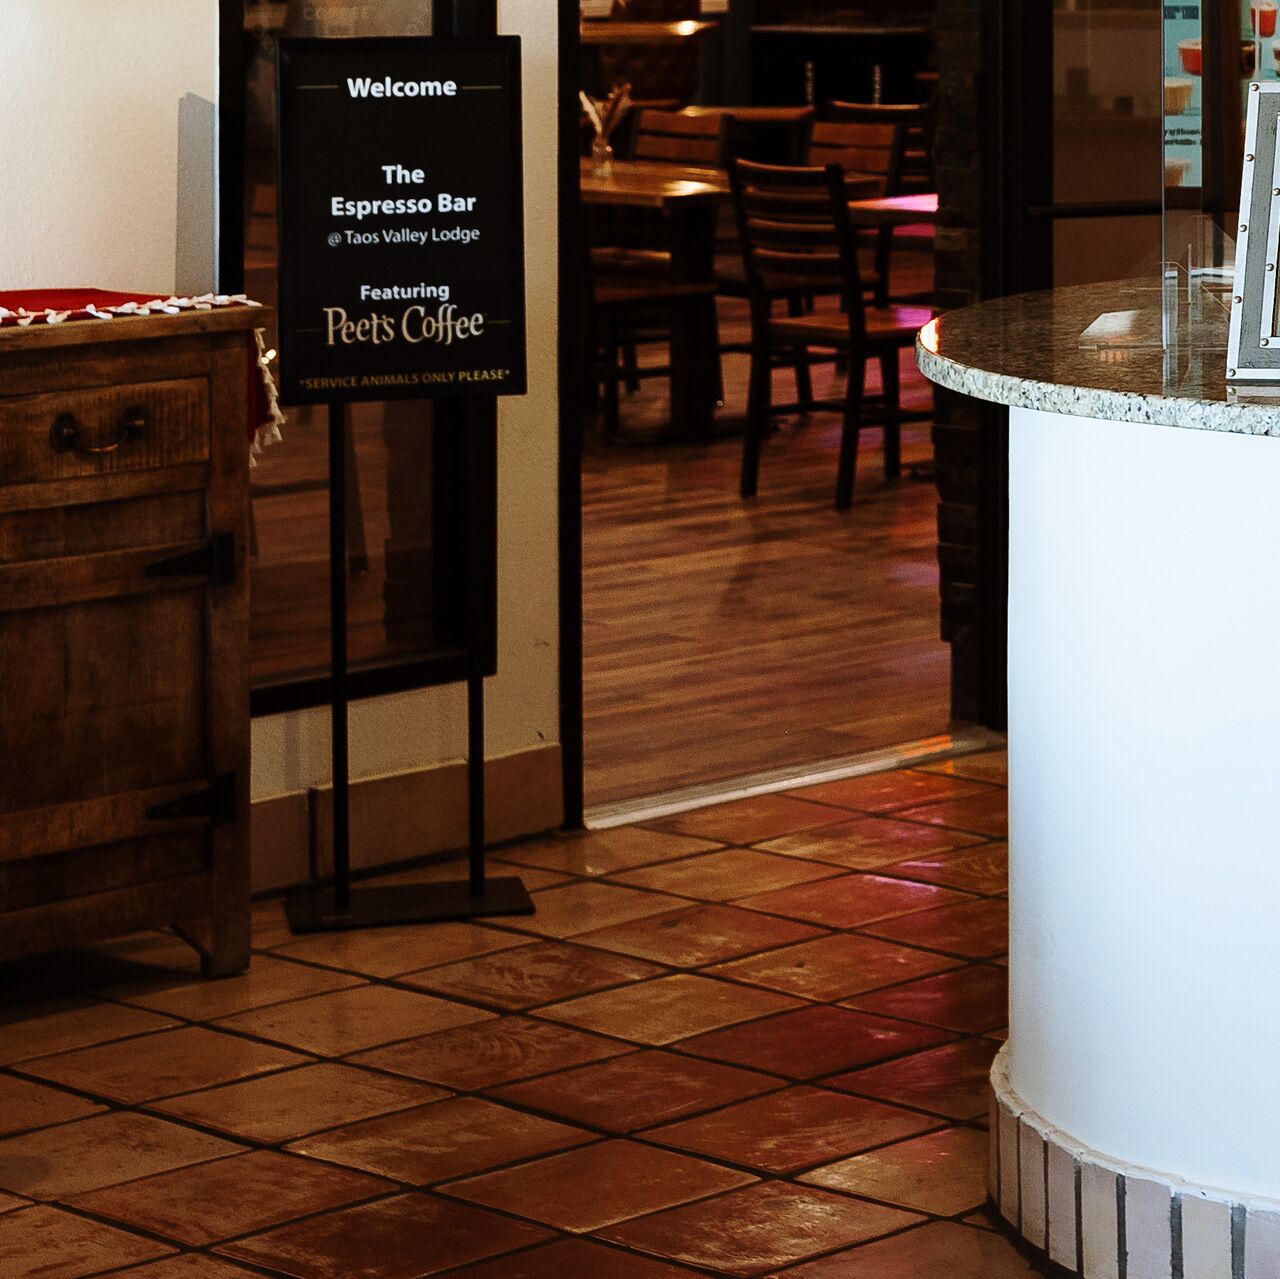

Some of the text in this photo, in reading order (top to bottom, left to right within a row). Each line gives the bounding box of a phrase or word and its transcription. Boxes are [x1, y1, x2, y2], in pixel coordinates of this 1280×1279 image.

[347, 77, 457, 98] Welcome
[382, 164, 425, 184] The
[331, 193, 476, 219] Espresso Bar
[328, 227, 480, 247] @ Taos Valley Lodge
[360, 282, 450, 301] Featuring
[322, 303, 486, 345] Peet's Coffee
[361, 373, 418, 388] ANIMALS
[422, 372, 456, 385] ONLY
